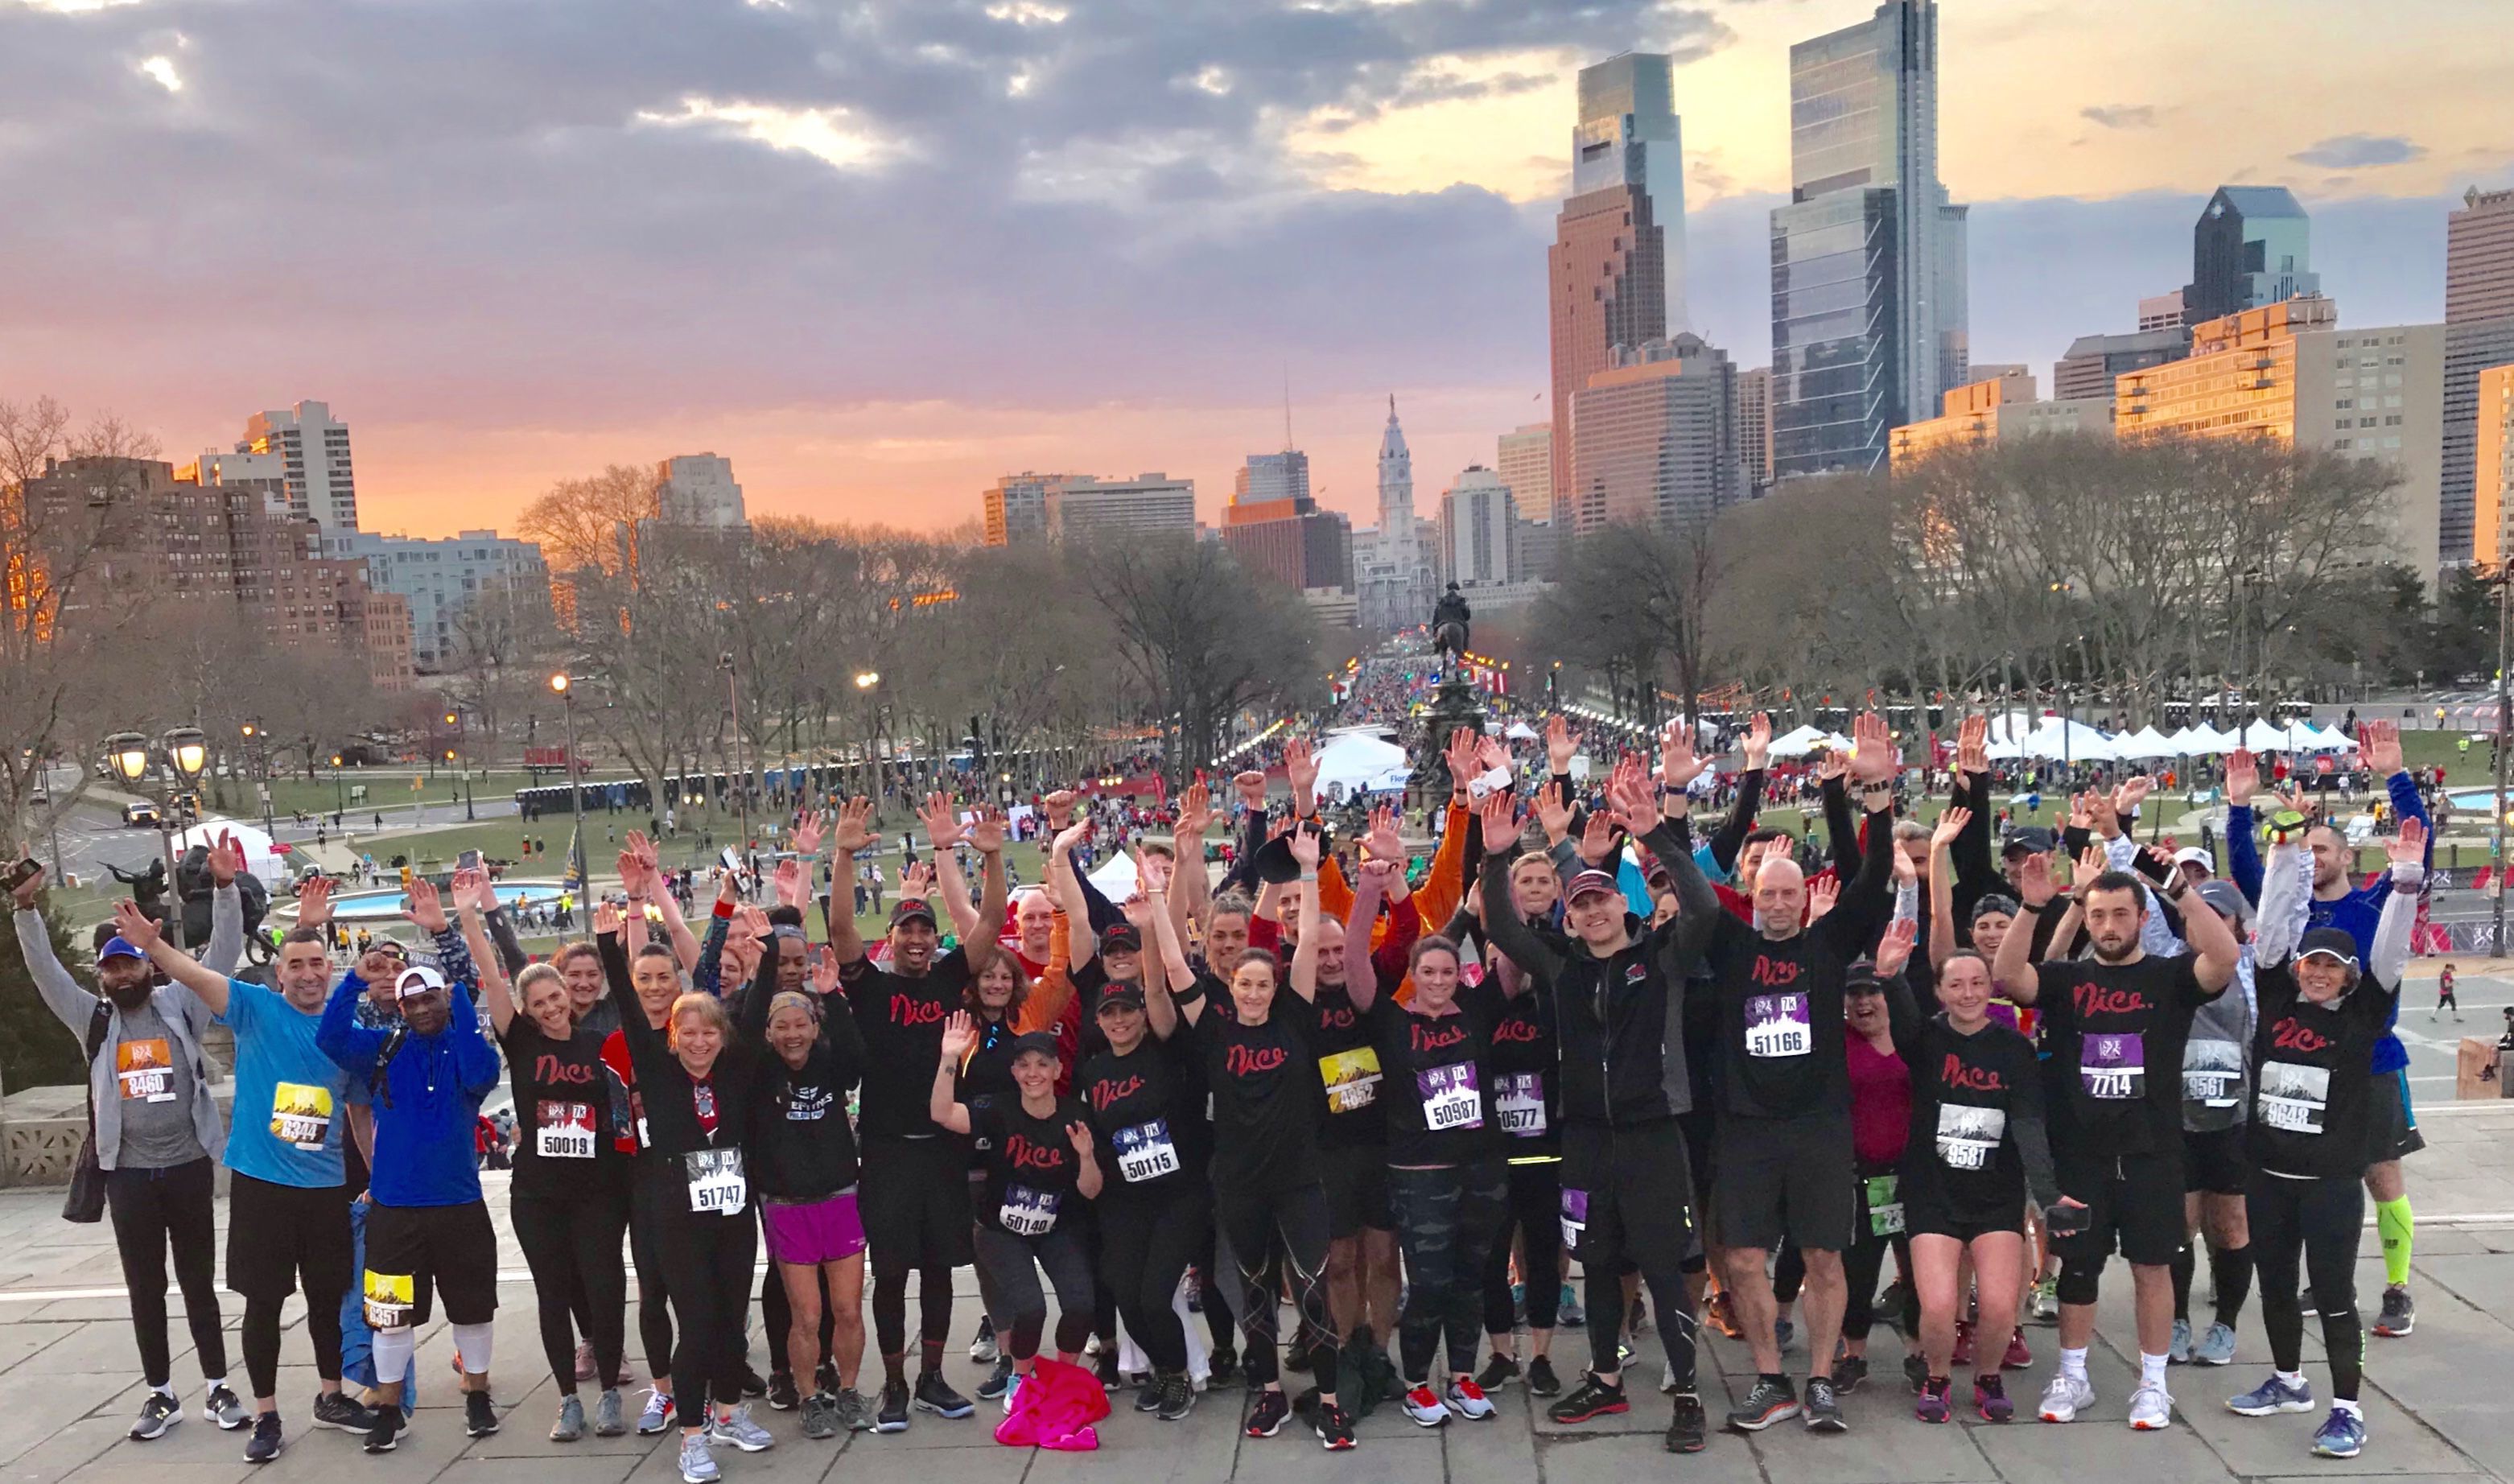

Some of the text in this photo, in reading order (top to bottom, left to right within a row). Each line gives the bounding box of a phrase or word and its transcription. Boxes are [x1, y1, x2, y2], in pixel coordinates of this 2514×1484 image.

[1754, 1032, 1803, 1053] 51166
[129, 1074, 165, 1094] 8460
[2092, 1075, 2132, 1095] 7714
[1433, 1099, 1476, 1125] 50987
[1498, 1108, 1537, 1128] 0577
[2267, 1102, 2310, 1124] 9648
[282, 1119, 318, 1140] 6344
[545, 1136, 587, 1154] 50019
[1947, 1144, 1987, 1167] 9581
[1127, 1152, 1171, 1178] 50115
[699, 1185, 740, 1206] 51747
[1006, 1214, 1048, 1233] 50140
[369, 1306, 399, 1326] 6351
